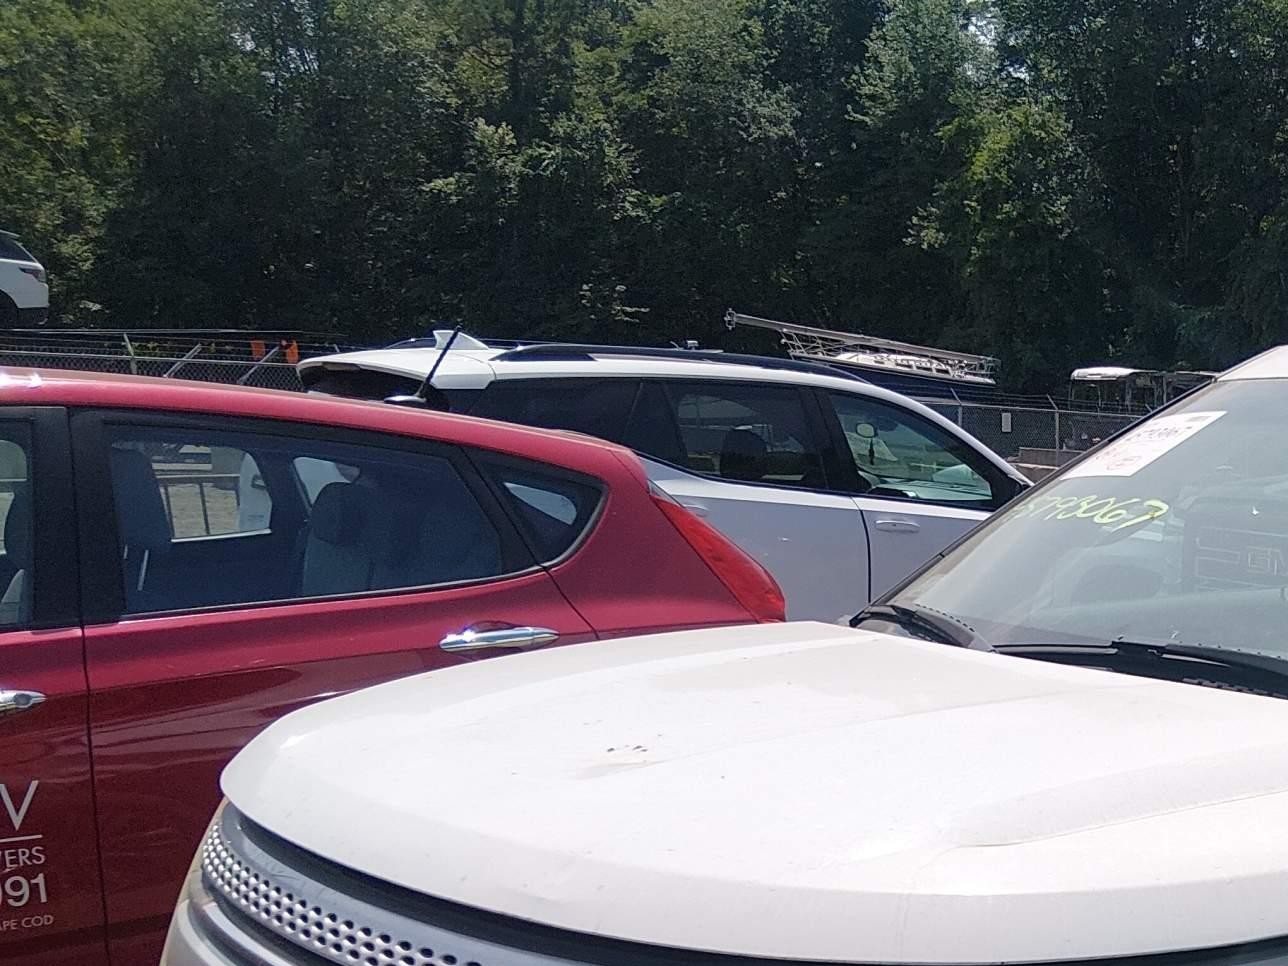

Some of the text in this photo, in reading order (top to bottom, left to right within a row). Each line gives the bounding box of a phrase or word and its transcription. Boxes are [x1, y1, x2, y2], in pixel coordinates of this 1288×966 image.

[0, 846, 46, 869] ERS
[0, 872, 48, 908] 91
[21, 914, 54, 928] COD
